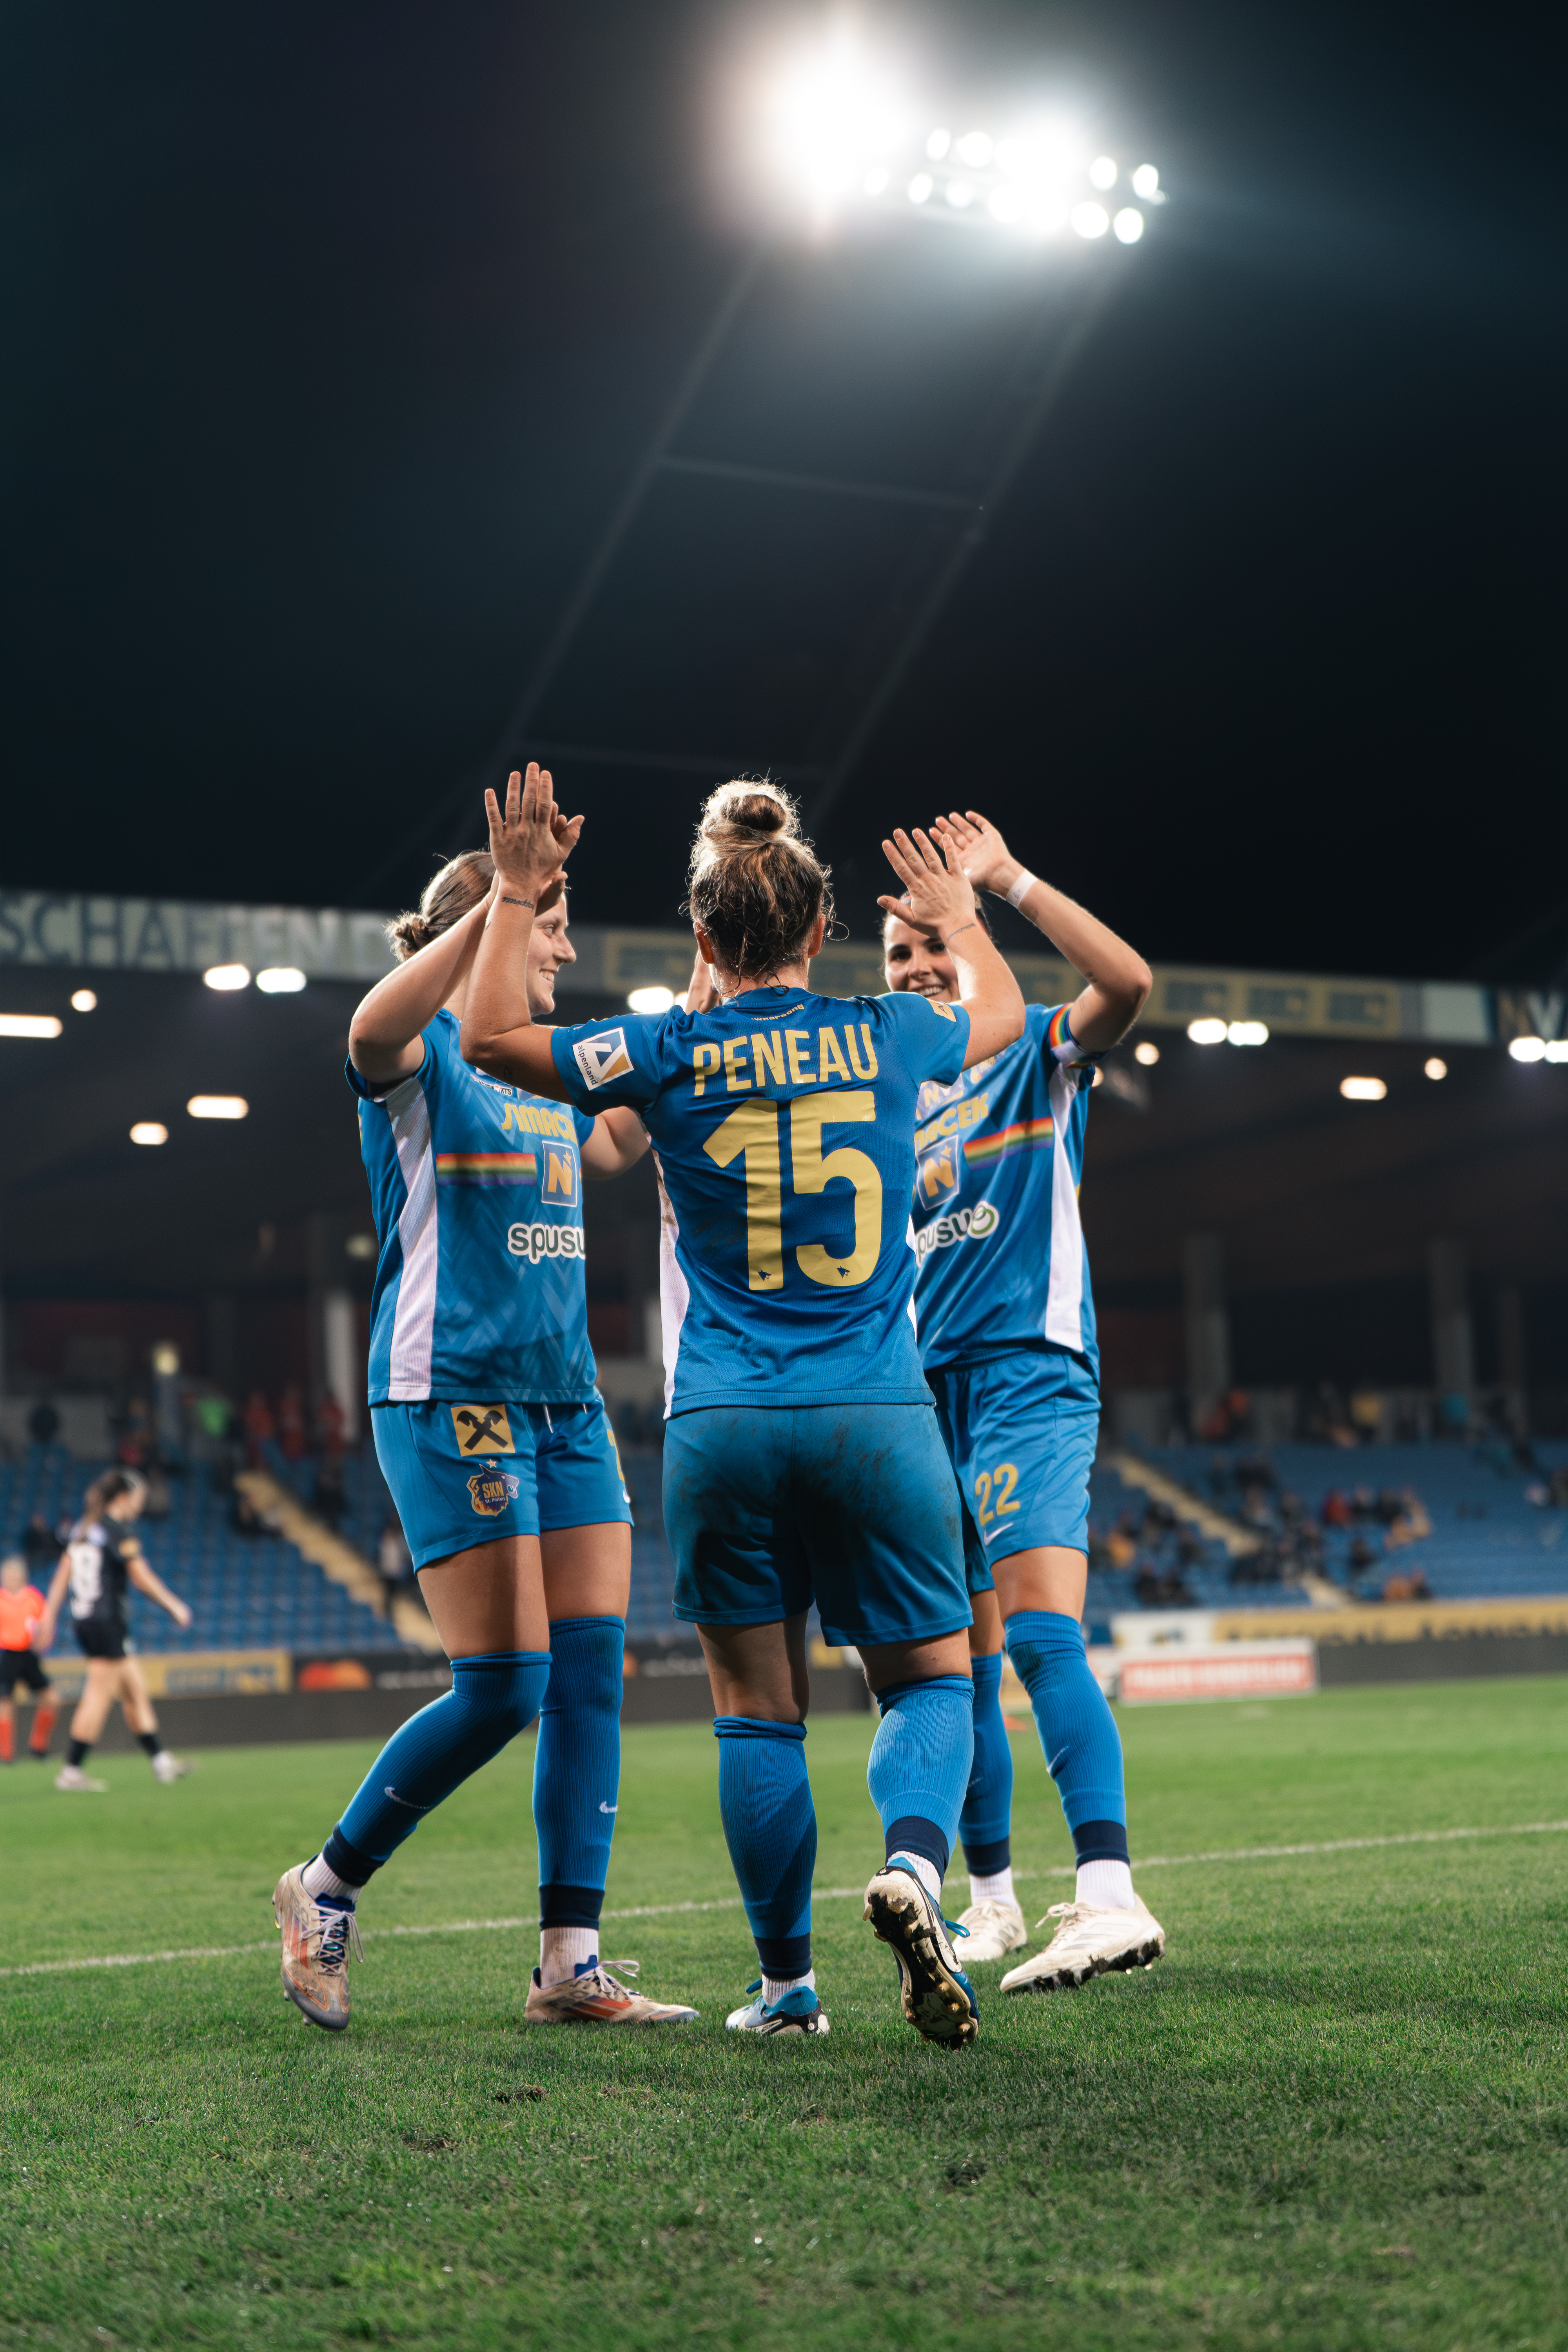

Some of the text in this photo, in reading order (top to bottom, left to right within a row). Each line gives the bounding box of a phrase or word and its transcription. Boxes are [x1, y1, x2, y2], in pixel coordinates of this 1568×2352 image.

[578, 1045, 598, 1085] alpenland
[693, 1024, 878, 1096] PENEAU
[914, 1093, 989, 1155] MACEK
[702, 1090, 883, 1290] 15
[482, 1481, 505, 1499] SKN
[975, 1464, 1020, 1527] 22
